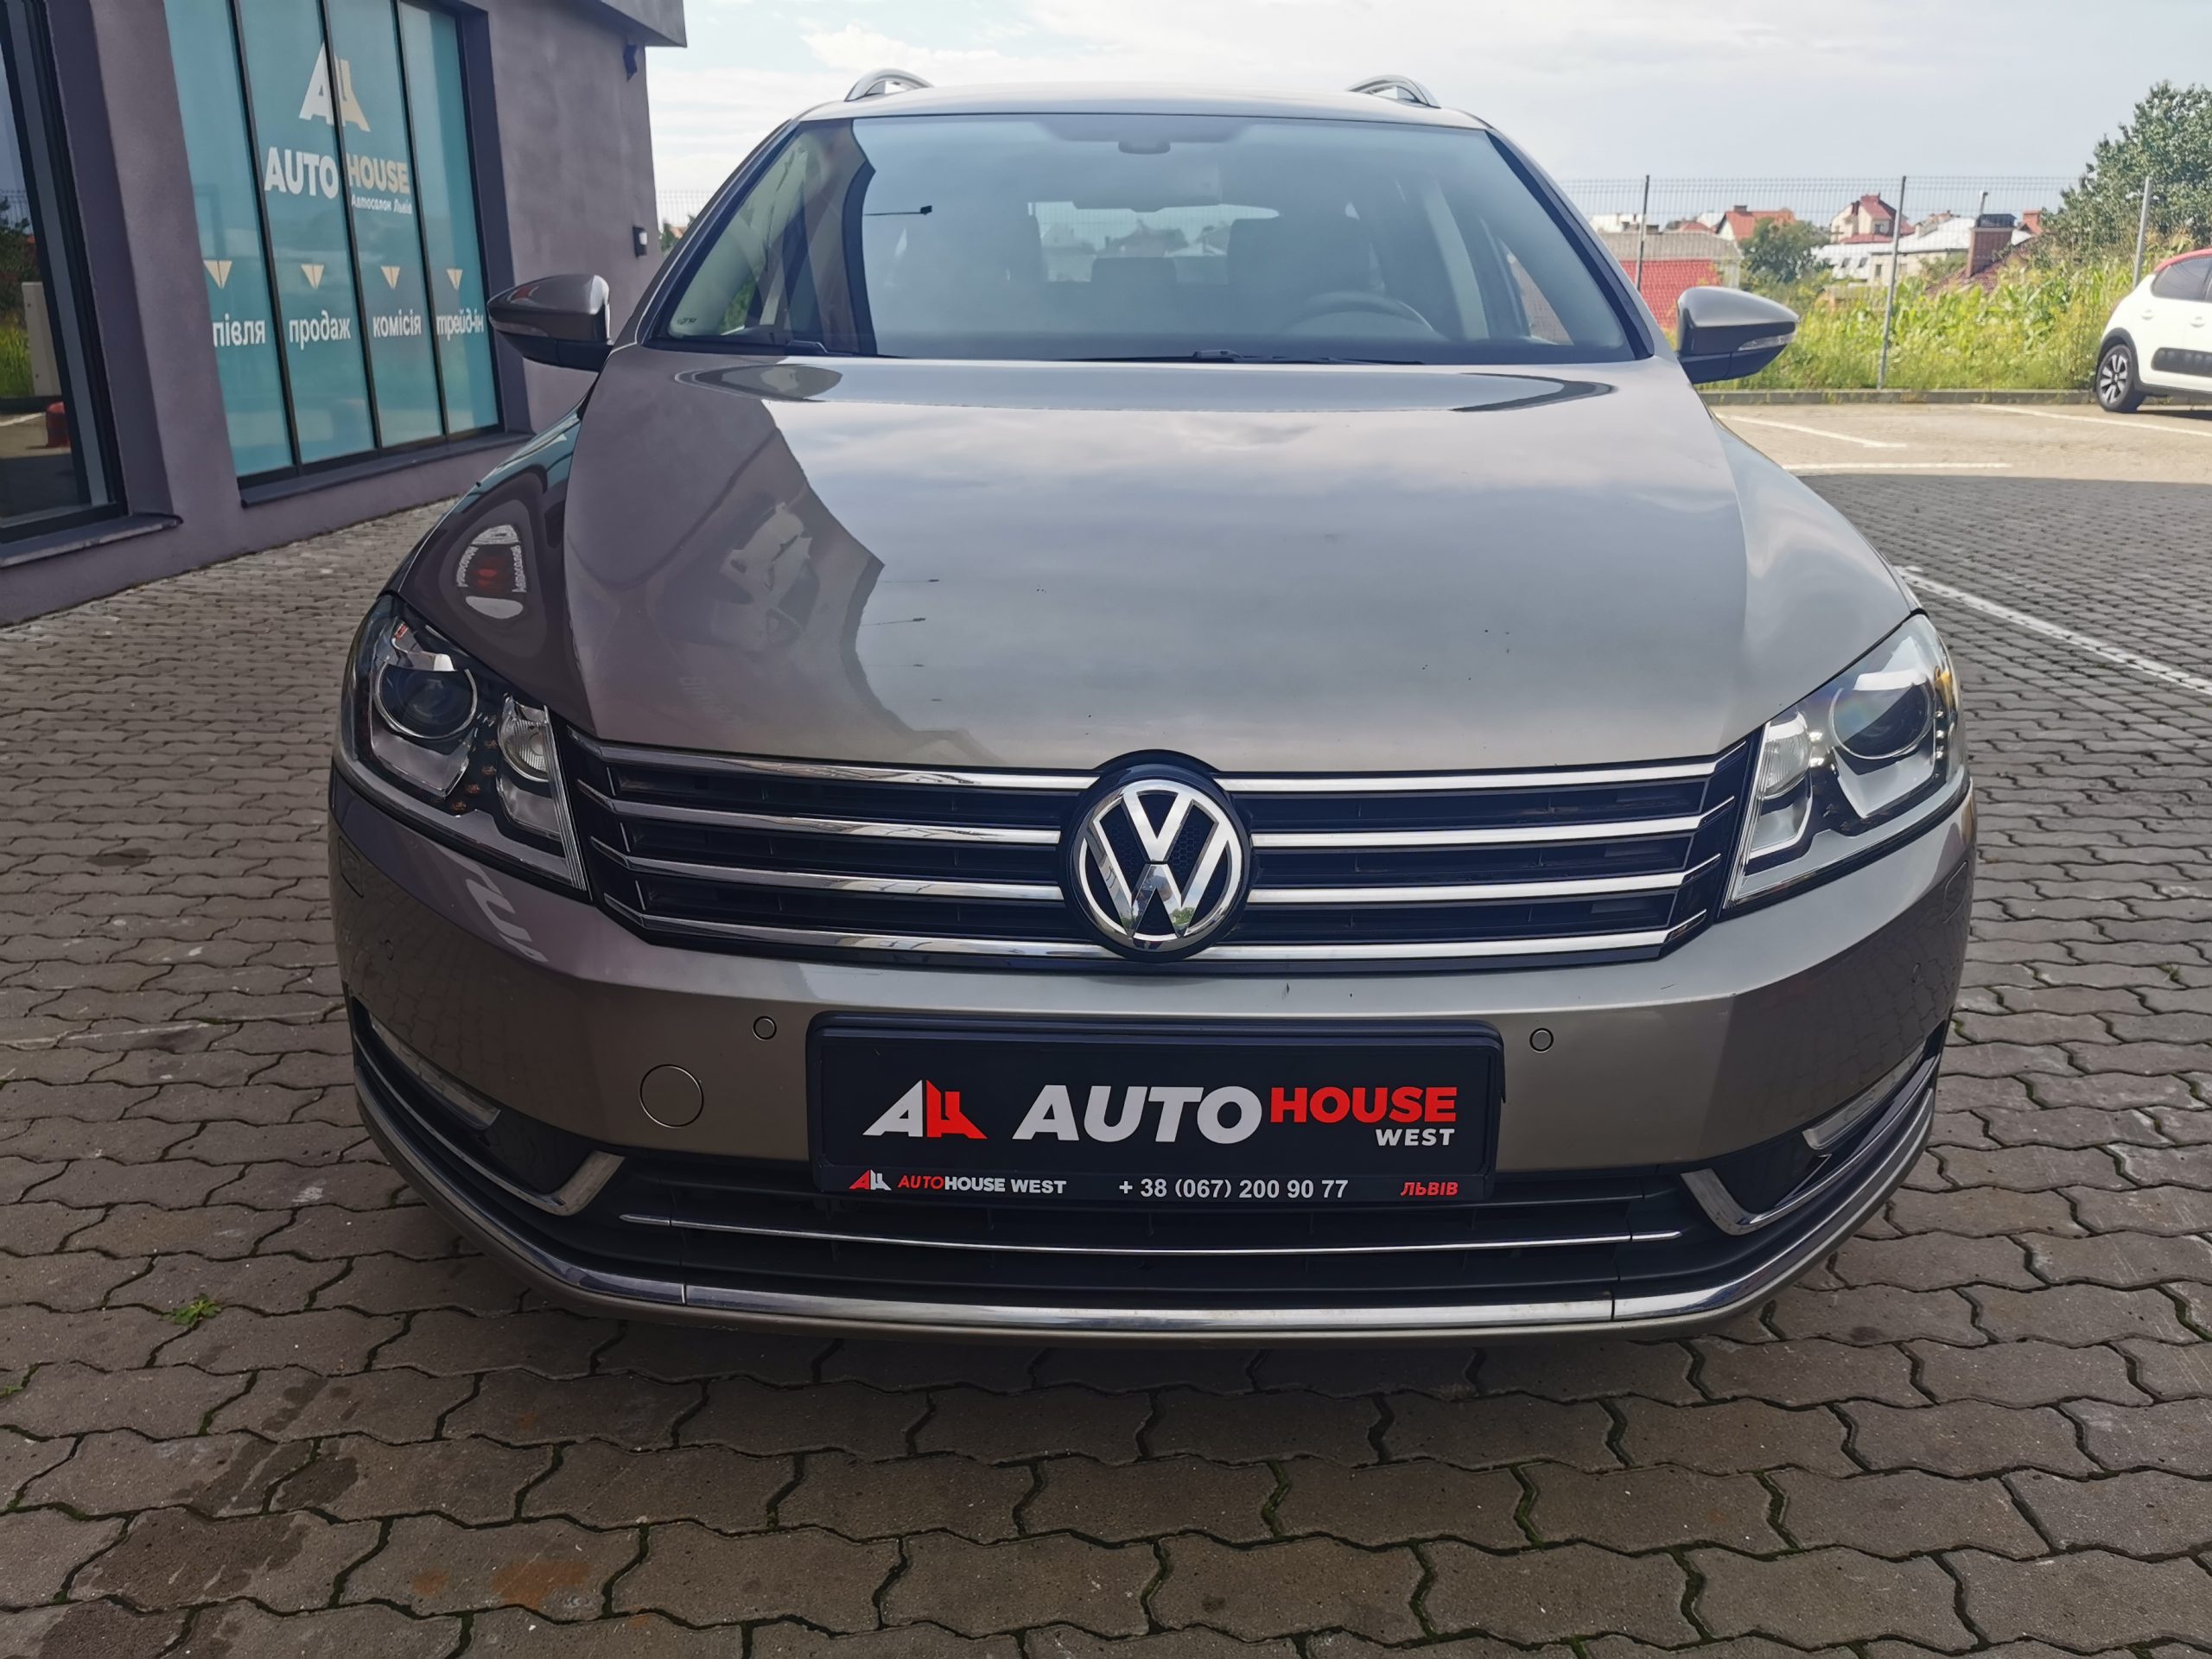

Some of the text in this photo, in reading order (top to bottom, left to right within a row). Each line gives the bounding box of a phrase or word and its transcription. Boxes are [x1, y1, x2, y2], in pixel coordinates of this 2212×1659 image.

[264, 147, 411, 200] AUTO HOUSE
[212, 313, 266, 347] півля
[289, 309, 352, 350] продаж
[372, 308, 422, 338] комісія
[1012, 1084, 1458, 1144] AUTO HOUSE
[1375, 1128, 1456, 1147] WEST
[1010, 1179, 1067, 1194] WEST
[1140, 1178, 1167, 1198] 38
[1174, 1179, 1232, 1199] (067)
[1238, 1179, 1280, 1199] 200
[1287, 1179, 1314, 1198] 90
[1321, 1179, 1349, 1198] 77
[1400, 1181, 1459, 1197] ЛЬВІВ
